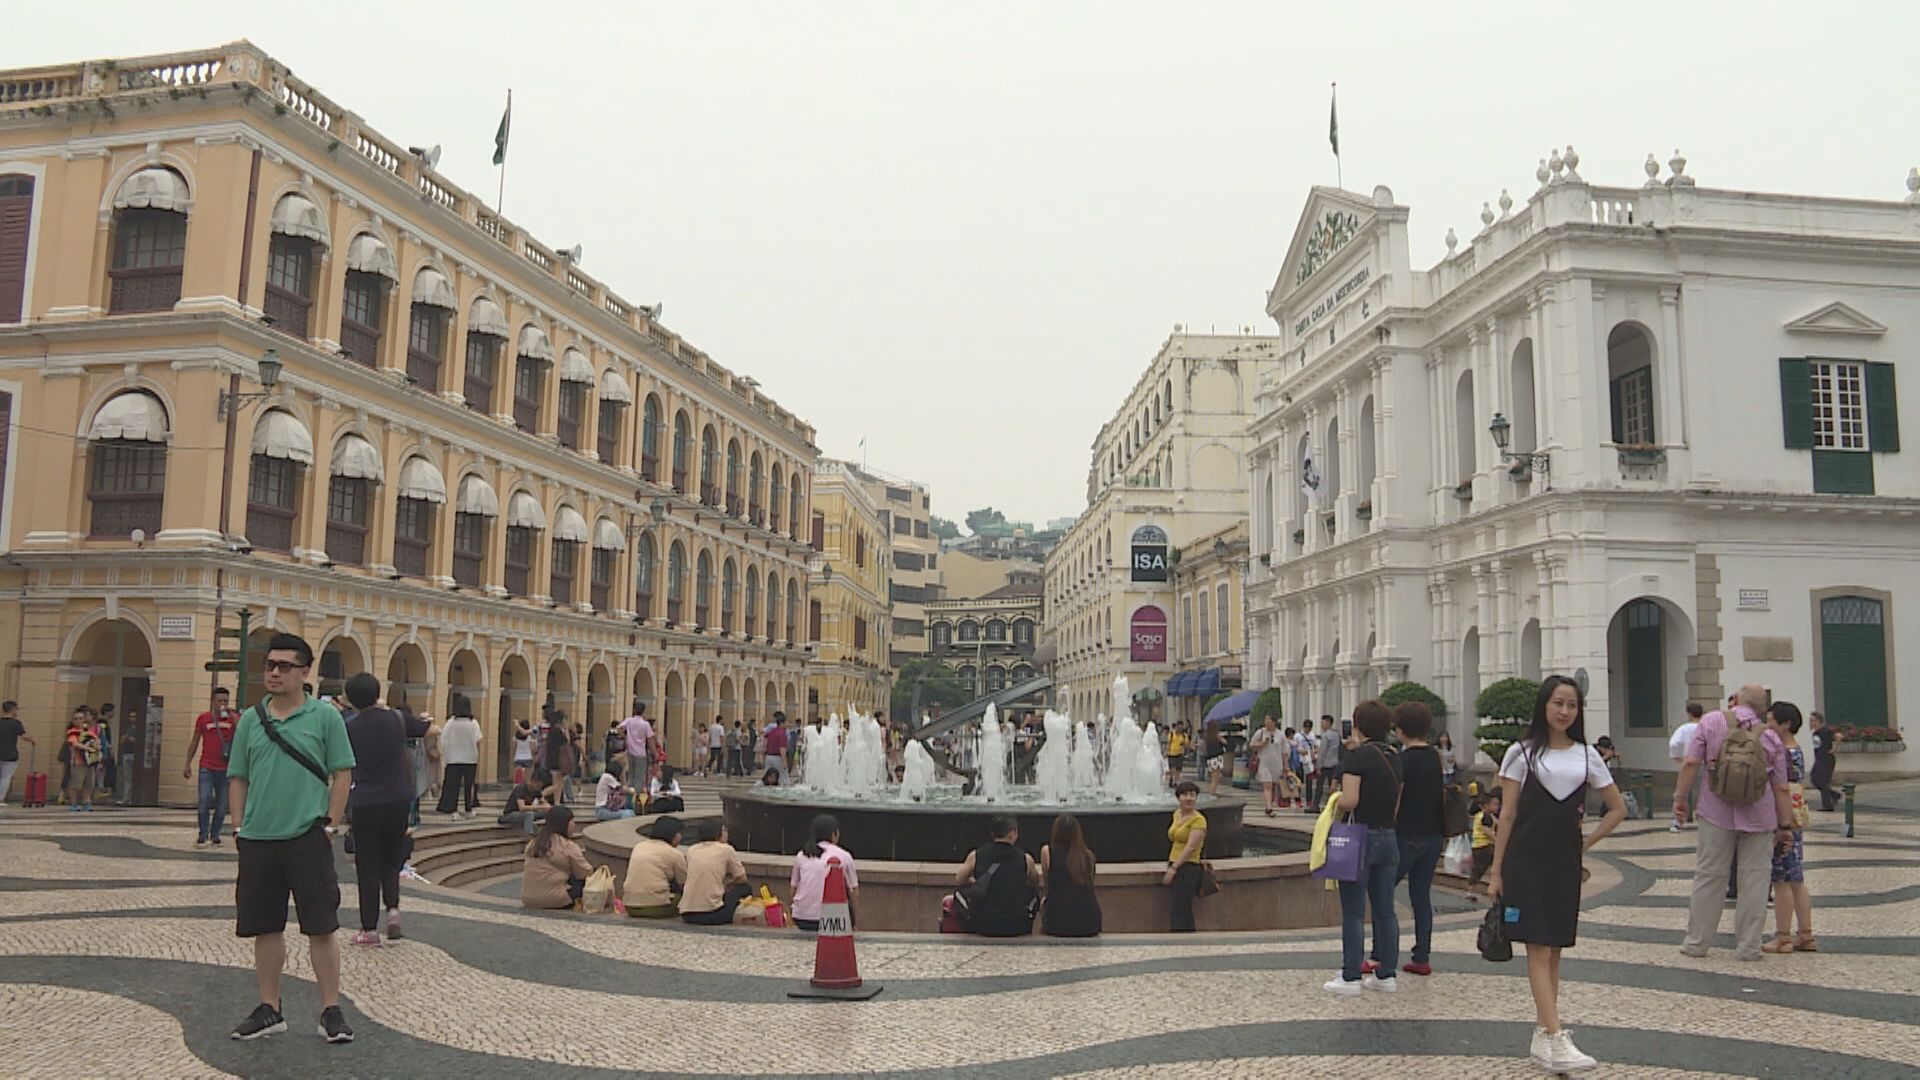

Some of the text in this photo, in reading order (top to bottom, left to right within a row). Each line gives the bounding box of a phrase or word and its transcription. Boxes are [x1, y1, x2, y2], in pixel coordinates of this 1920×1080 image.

[1311, 302, 1325, 322] CASA
[1326, 295, 1335, 311] DA
[1134, 552, 1165, 569] ISA
